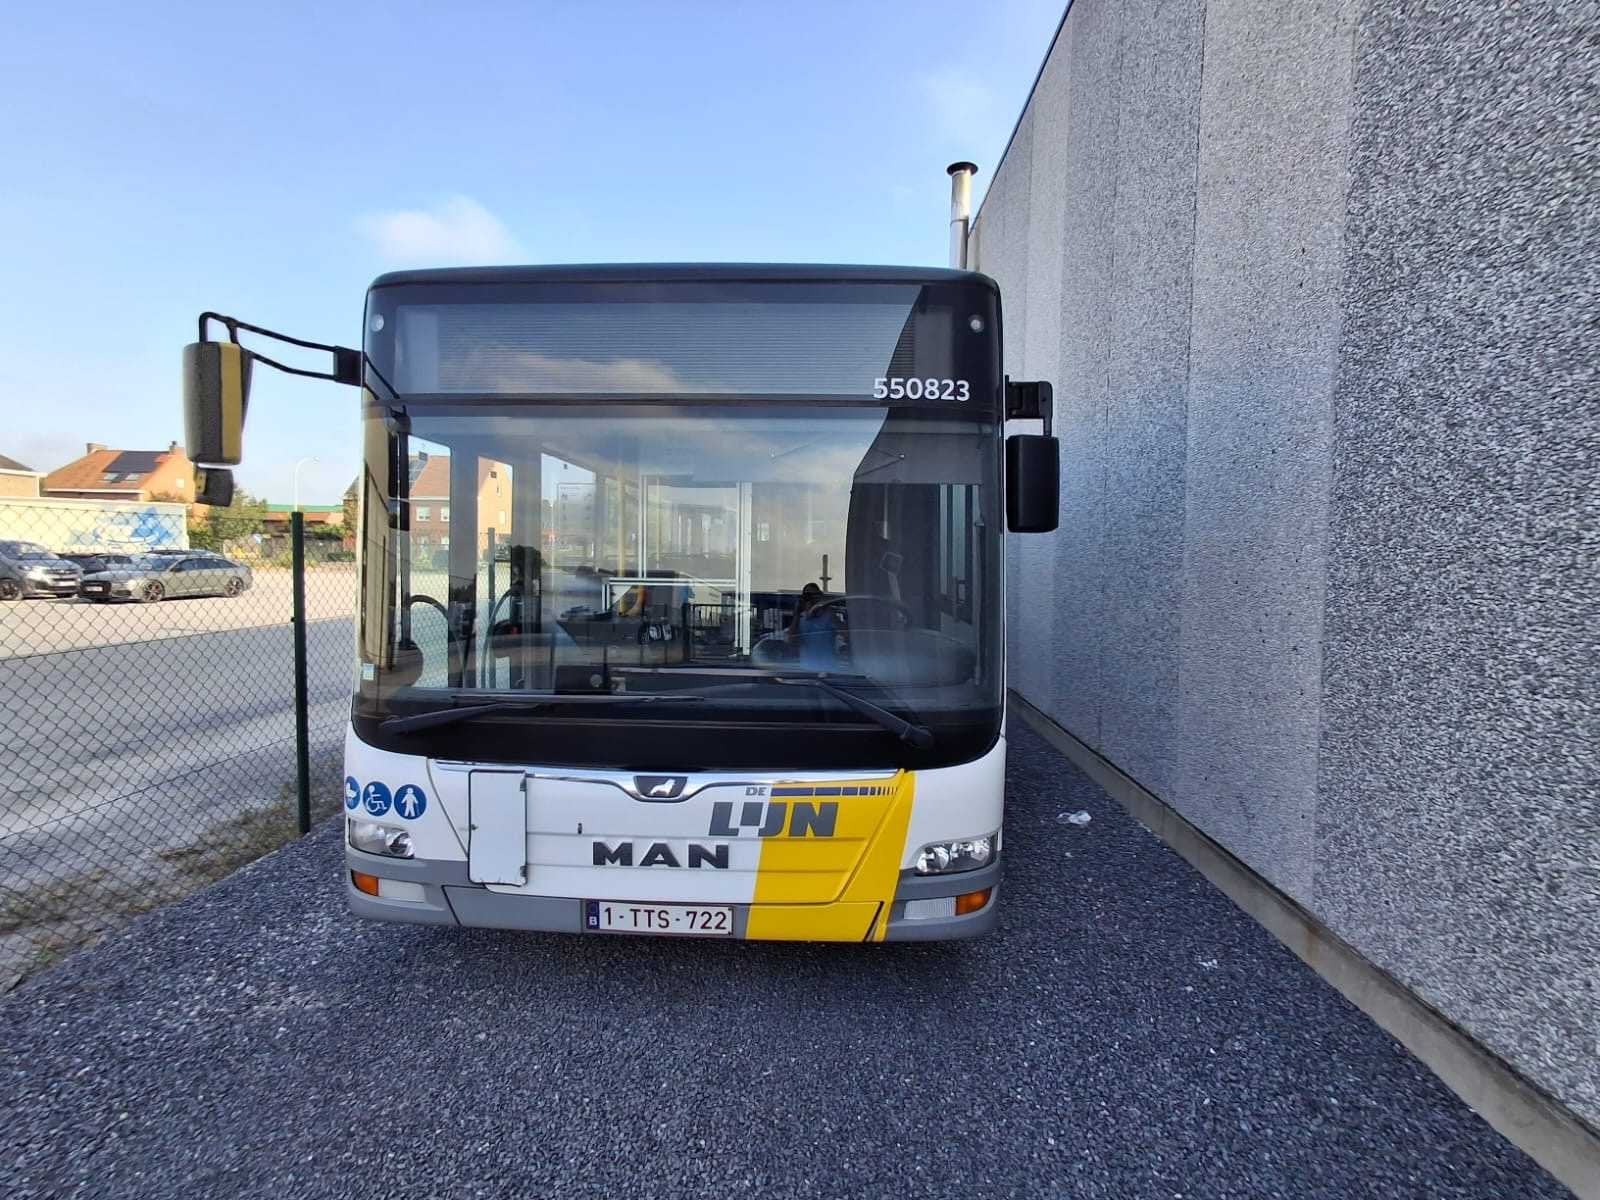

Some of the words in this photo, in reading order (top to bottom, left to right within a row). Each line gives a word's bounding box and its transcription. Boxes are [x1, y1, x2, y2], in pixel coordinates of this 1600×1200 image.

[873, 377, 970, 401] 550823
[745, 786, 767, 797] DE
[592, 841, 729, 869] MAN
[589, 915, 598, 926] B
[604, 906, 728, 931] 1-TTS-722
